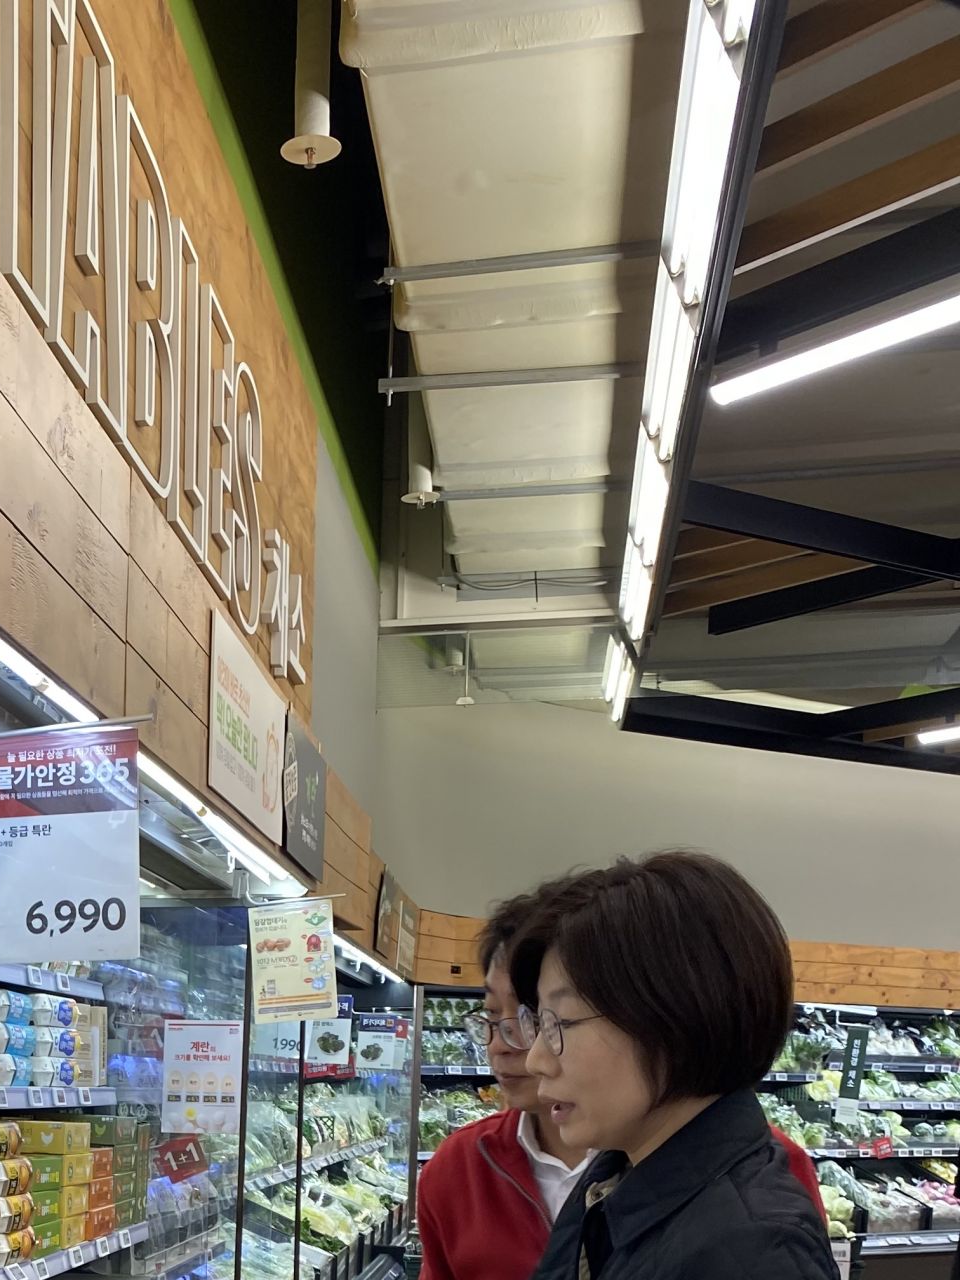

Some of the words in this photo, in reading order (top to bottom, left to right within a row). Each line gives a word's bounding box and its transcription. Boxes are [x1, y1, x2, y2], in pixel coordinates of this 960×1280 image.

[18, 751, 44, 762] 필요한
[46, 749, 64, 759] 상품
[80, 758, 130, 784] 365
[9, 826, 28, 838] 등급
[31, 824, 52, 837] 특란
[26, 897, 127, 938] 6,990
[164, 1142, 200, 1171] 1+1
